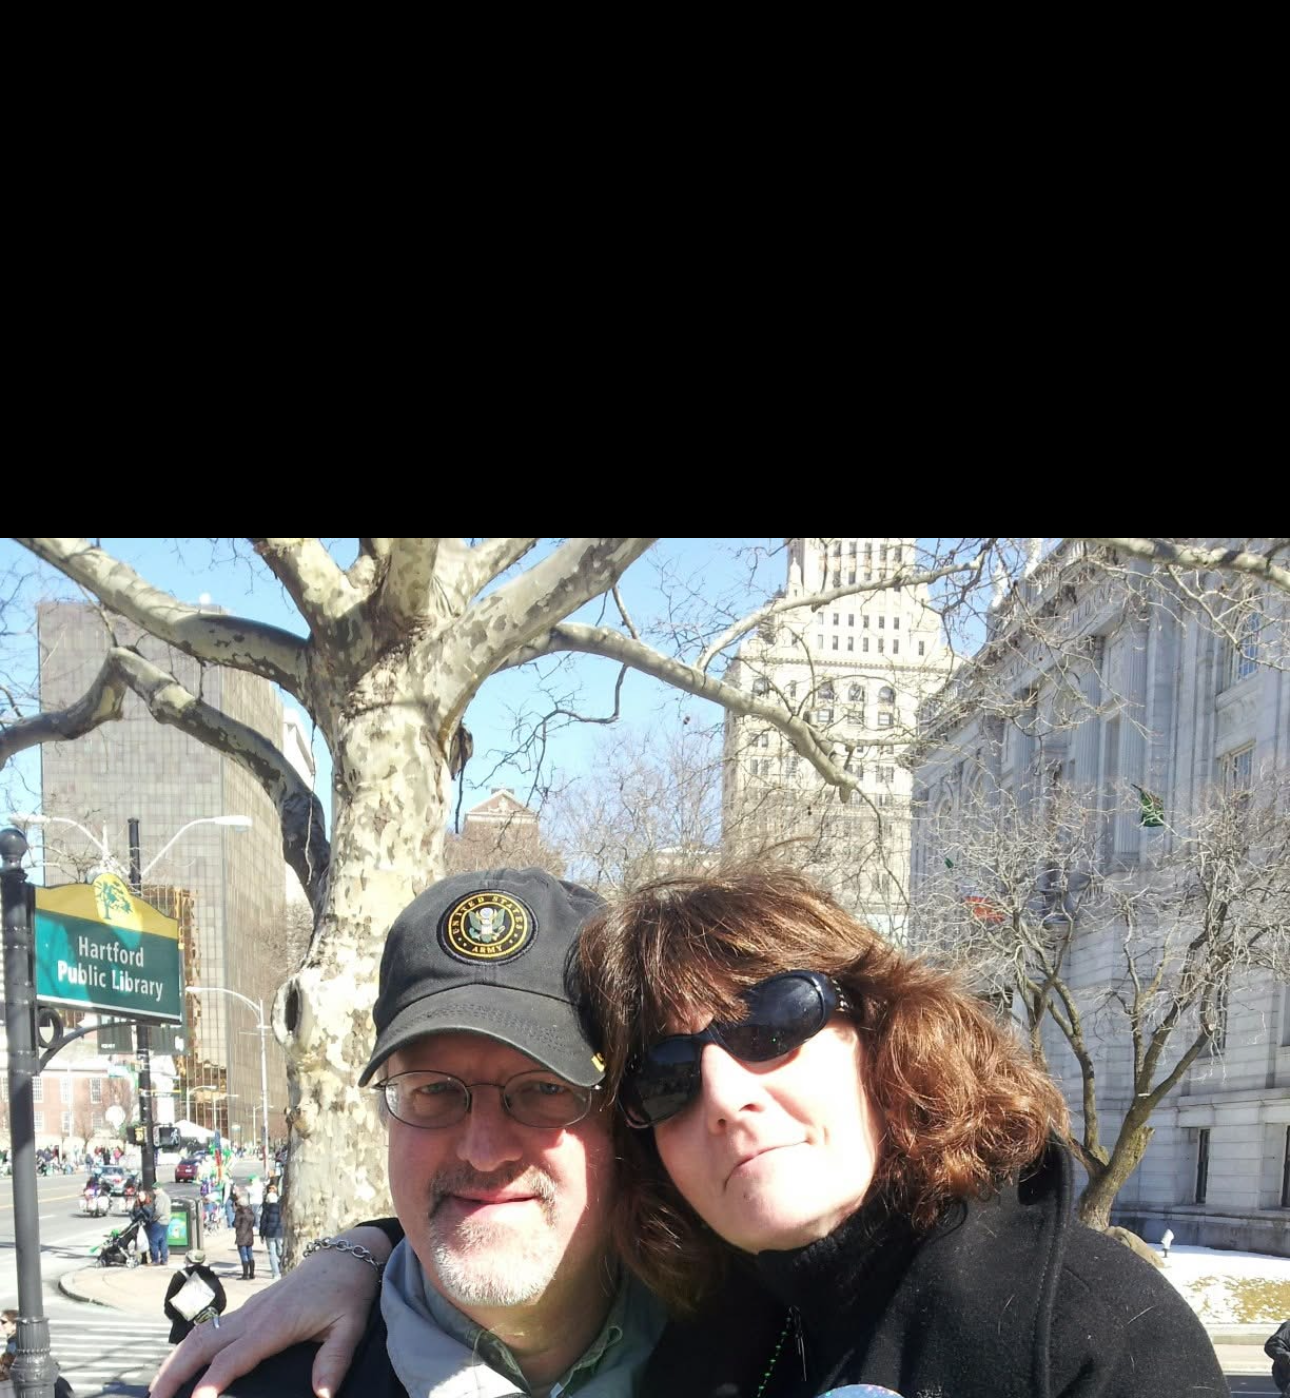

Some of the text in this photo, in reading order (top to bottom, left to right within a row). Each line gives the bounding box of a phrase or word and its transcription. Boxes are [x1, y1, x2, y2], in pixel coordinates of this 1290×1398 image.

[452, 896, 523, 934] UNITED STATES
[78, 936, 144, 967] Hartford
[472, 945, 503, 953] ARMY
[57, 960, 163, 1002] Public Library
